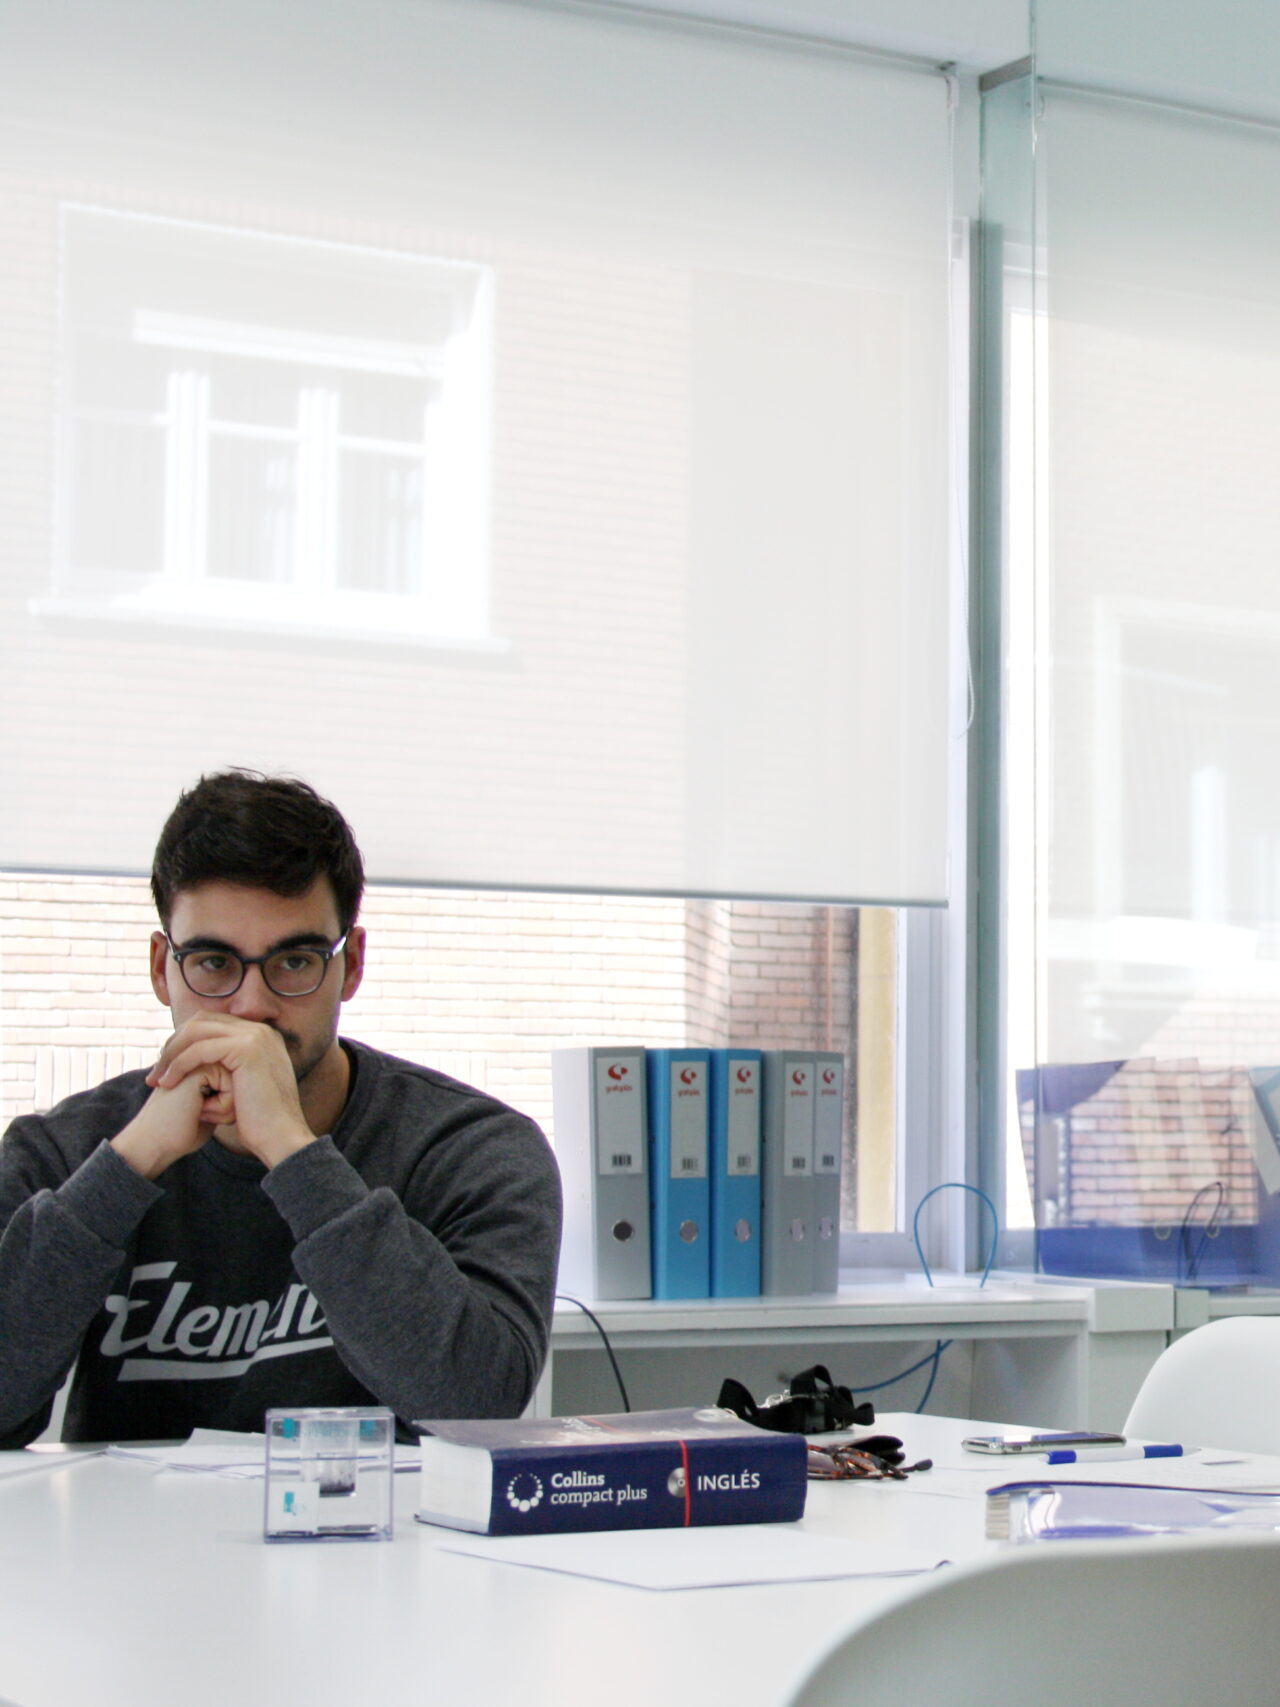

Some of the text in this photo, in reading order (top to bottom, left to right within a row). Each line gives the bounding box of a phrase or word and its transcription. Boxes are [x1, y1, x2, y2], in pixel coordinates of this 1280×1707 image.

[551, 1470, 606, 1488] Collins
[697, 1469, 761, 1491] INGLÉS
[550, 1484, 648, 1508] compact plus
